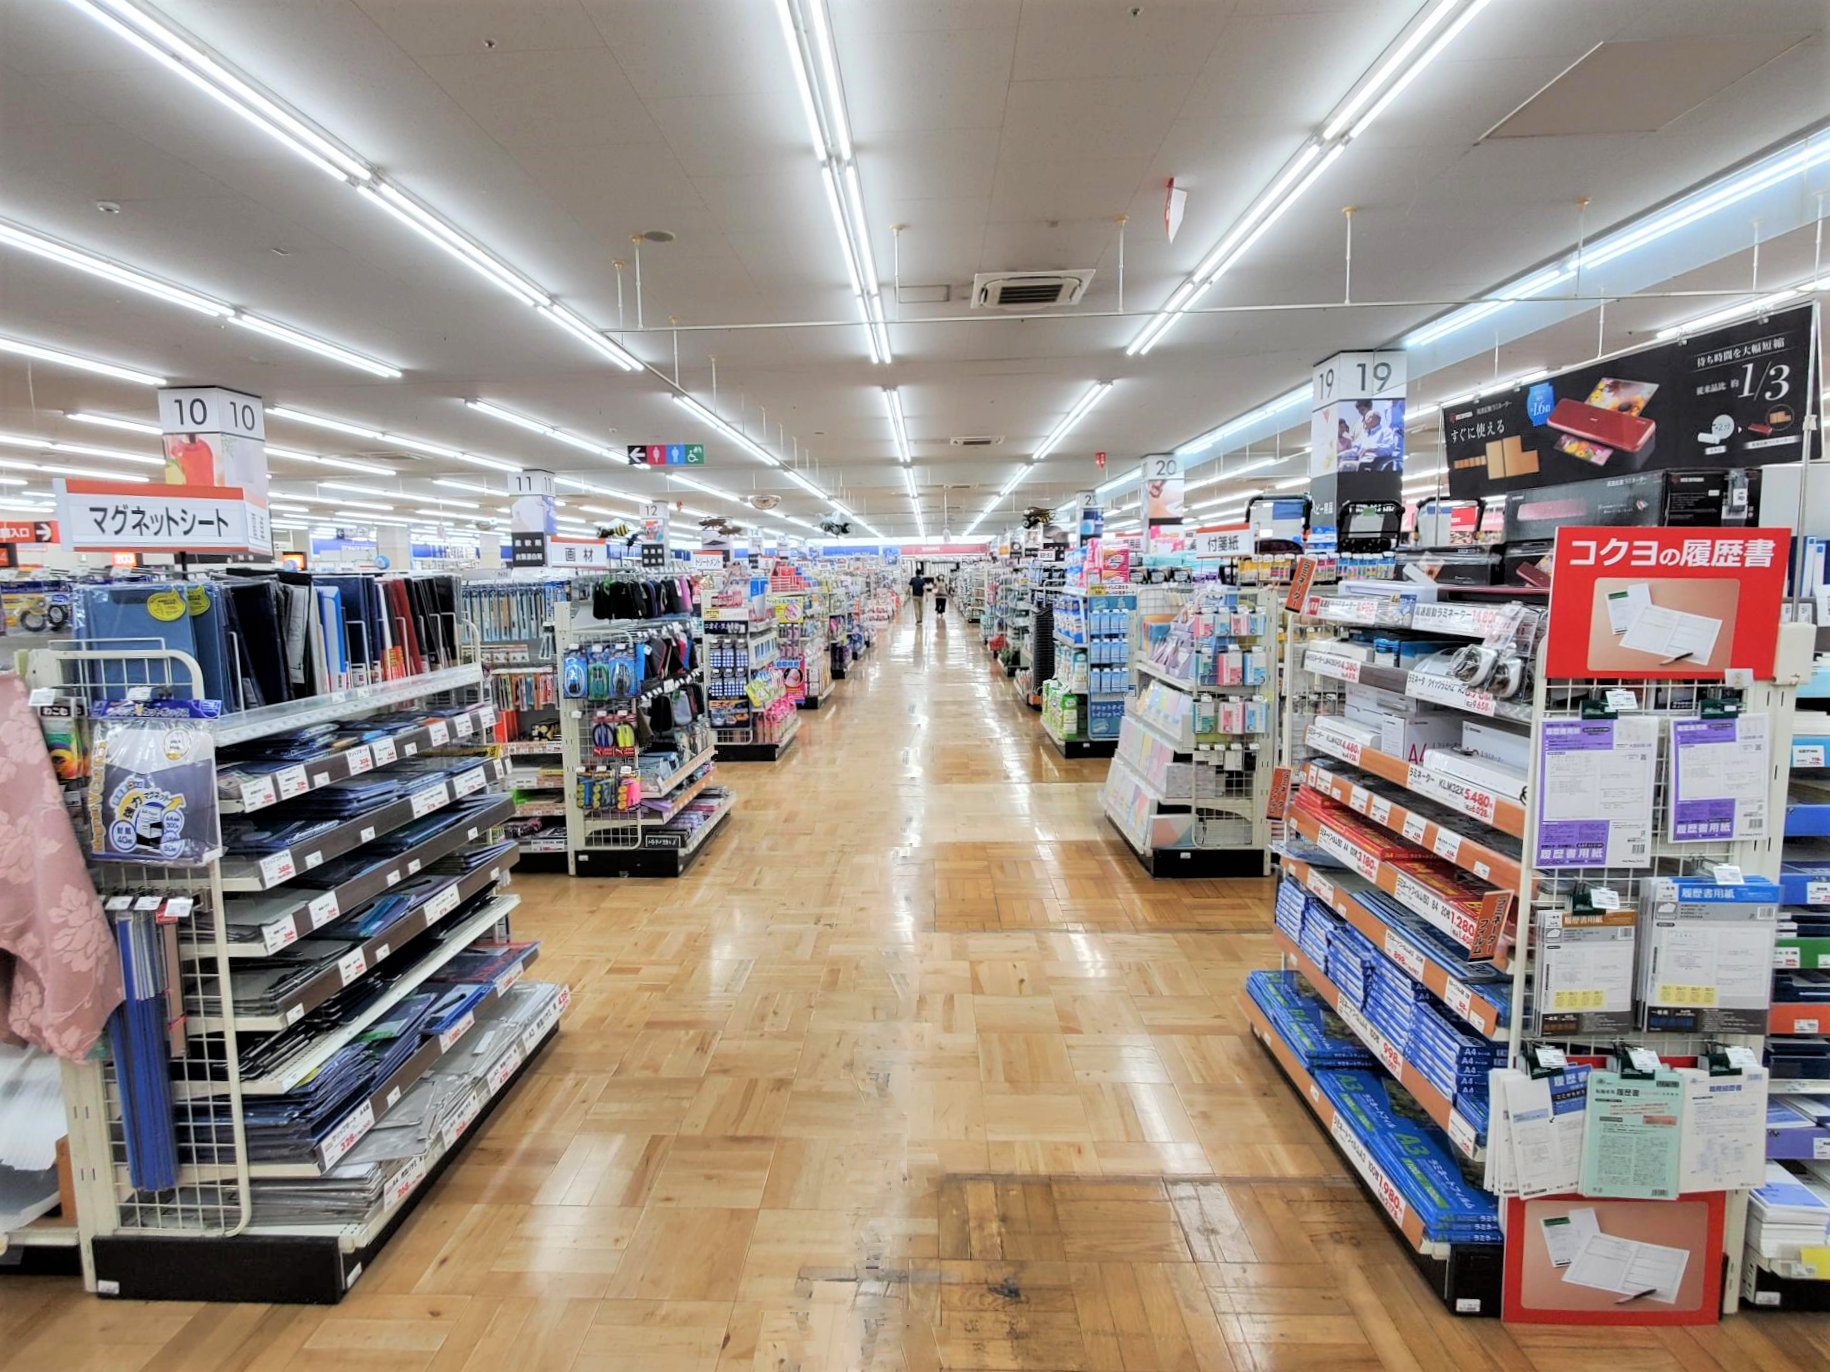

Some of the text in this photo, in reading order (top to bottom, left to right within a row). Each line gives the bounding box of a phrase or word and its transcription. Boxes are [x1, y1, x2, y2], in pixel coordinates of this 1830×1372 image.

[1697, 337, 1785, 367] 待ち時間を大幅短縮
[1319, 368, 1334, 400] 19
[1356, 362, 1392, 392] 19
[1737, 361, 1790, 401] 1/3
[174, 398, 207, 425] 10
[230, 401, 255, 431] 10
[1451, 419, 1505, 443] すぐに使える
[1156, 460, 1177, 476] 20
[516, 476, 532, 491] 11
[543, 476, 552, 492] 11
[645, 505, 658, 516] 12
[89, 504, 229, 538] マグネットシート
[1207, 535, 1240, 552] 付箋紙
[1569, 537, 1776, 567] コクヨの履歴書
[114, 552, 135, 564] 203
[564, 547, 594, 562] 画材
[695, 558, 721, 567] トリートメント
[1409, 766, 1435, 783] ラミネーター
[1438, 777, 1464, 796] KLM32X
[143, 790, 170, 802] マグネット
[1676, 822, 1732, 834] 履歴書用紙
[1540, 849, 1603, 859] 履歴書用紙
[1682, 887, 1735, 899] 履歴書用紙
[1486, 895, 1507, 954] ラミネーター
[1473, 919, 1489, 954] フィルム
[1464, 1048, 1477, 1056] A4
[1464, 1066, 1477, 1074] A4
[1335, 1073, 1364, 1091] A3
[1395, 1132, 1430, 1155] A3
[1428, 1159, 1475, 1209] ラミネートフィルム
